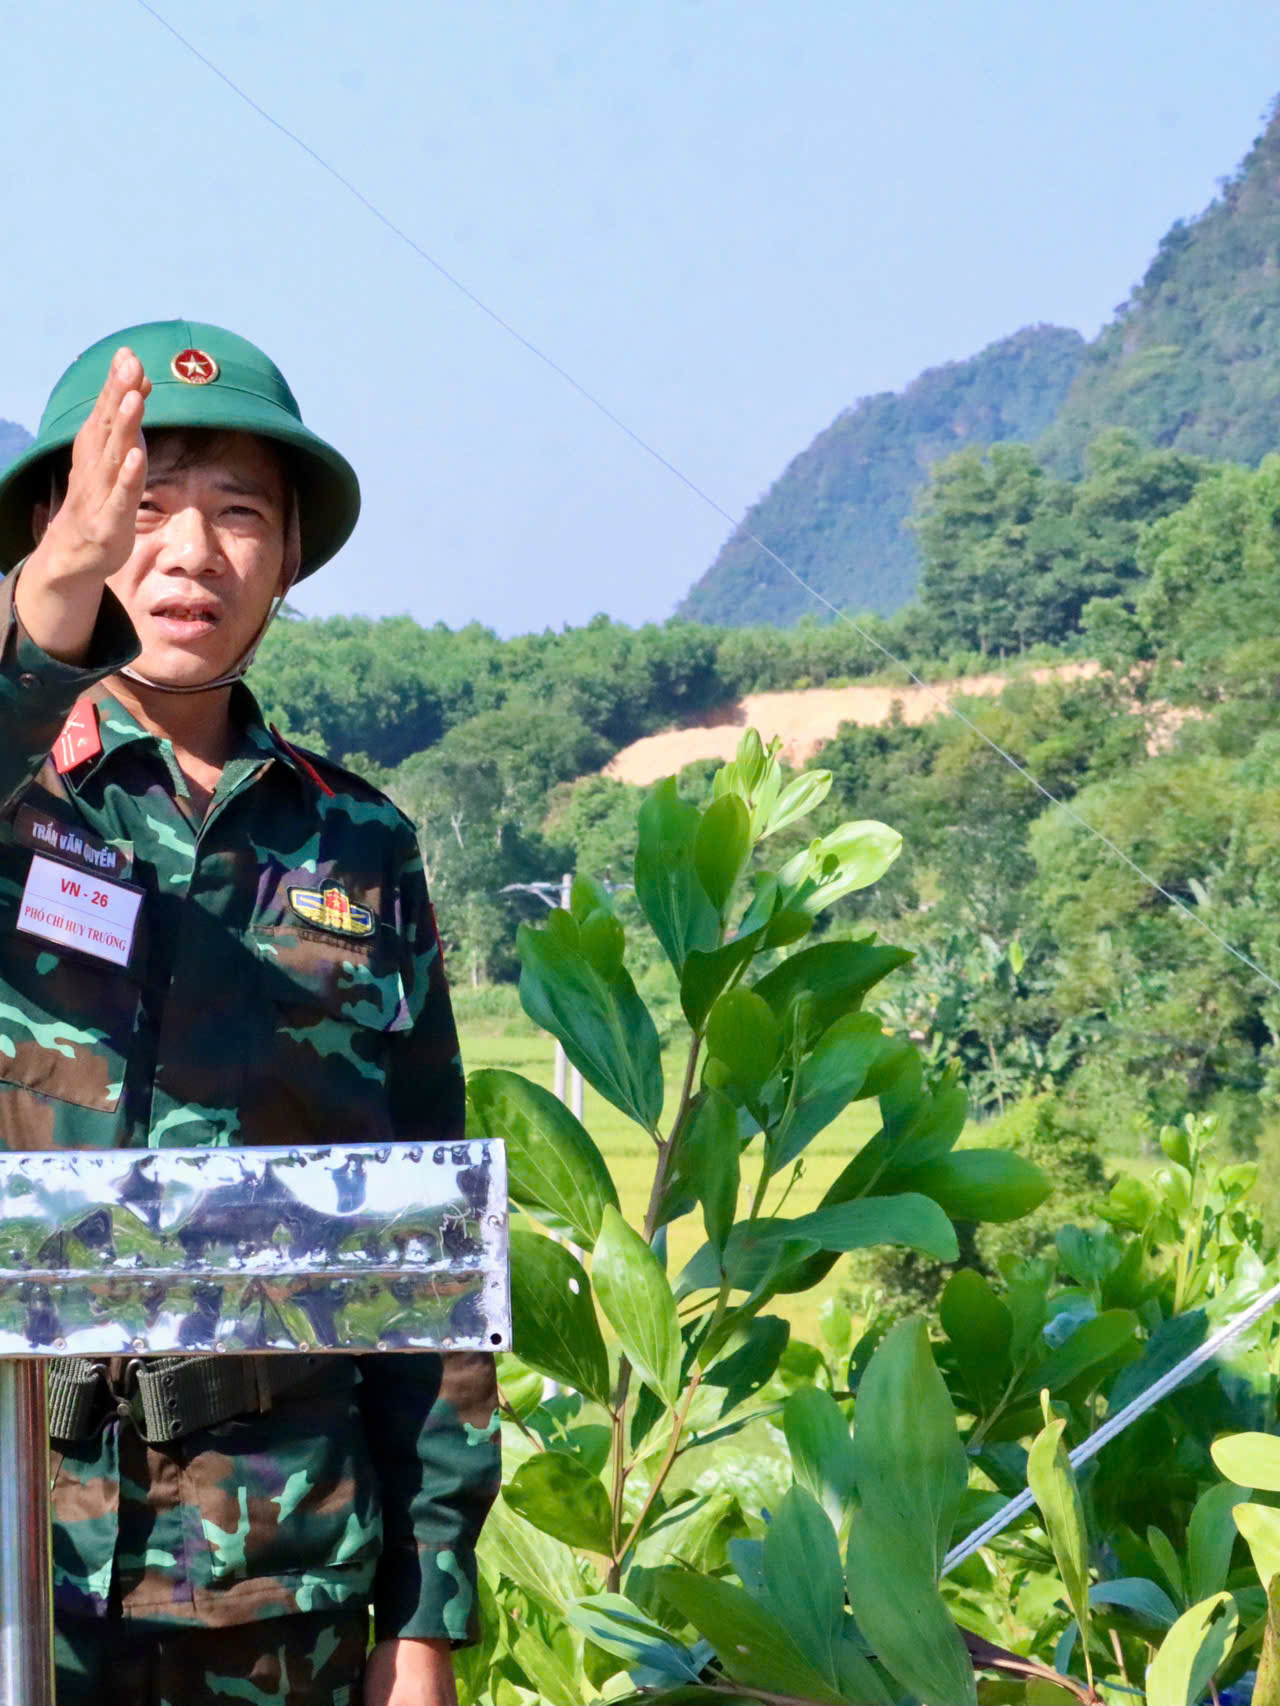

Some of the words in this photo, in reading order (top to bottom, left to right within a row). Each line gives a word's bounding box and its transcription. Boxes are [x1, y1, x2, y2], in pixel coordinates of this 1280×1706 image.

[60, 833, 82, 855] VĂN
[61, 878, 81, 897] VN
[91, 891, 109, 908] 26
[24, 905, 45, 923] PHÓ
[65, 920, 86, 937] HUY
